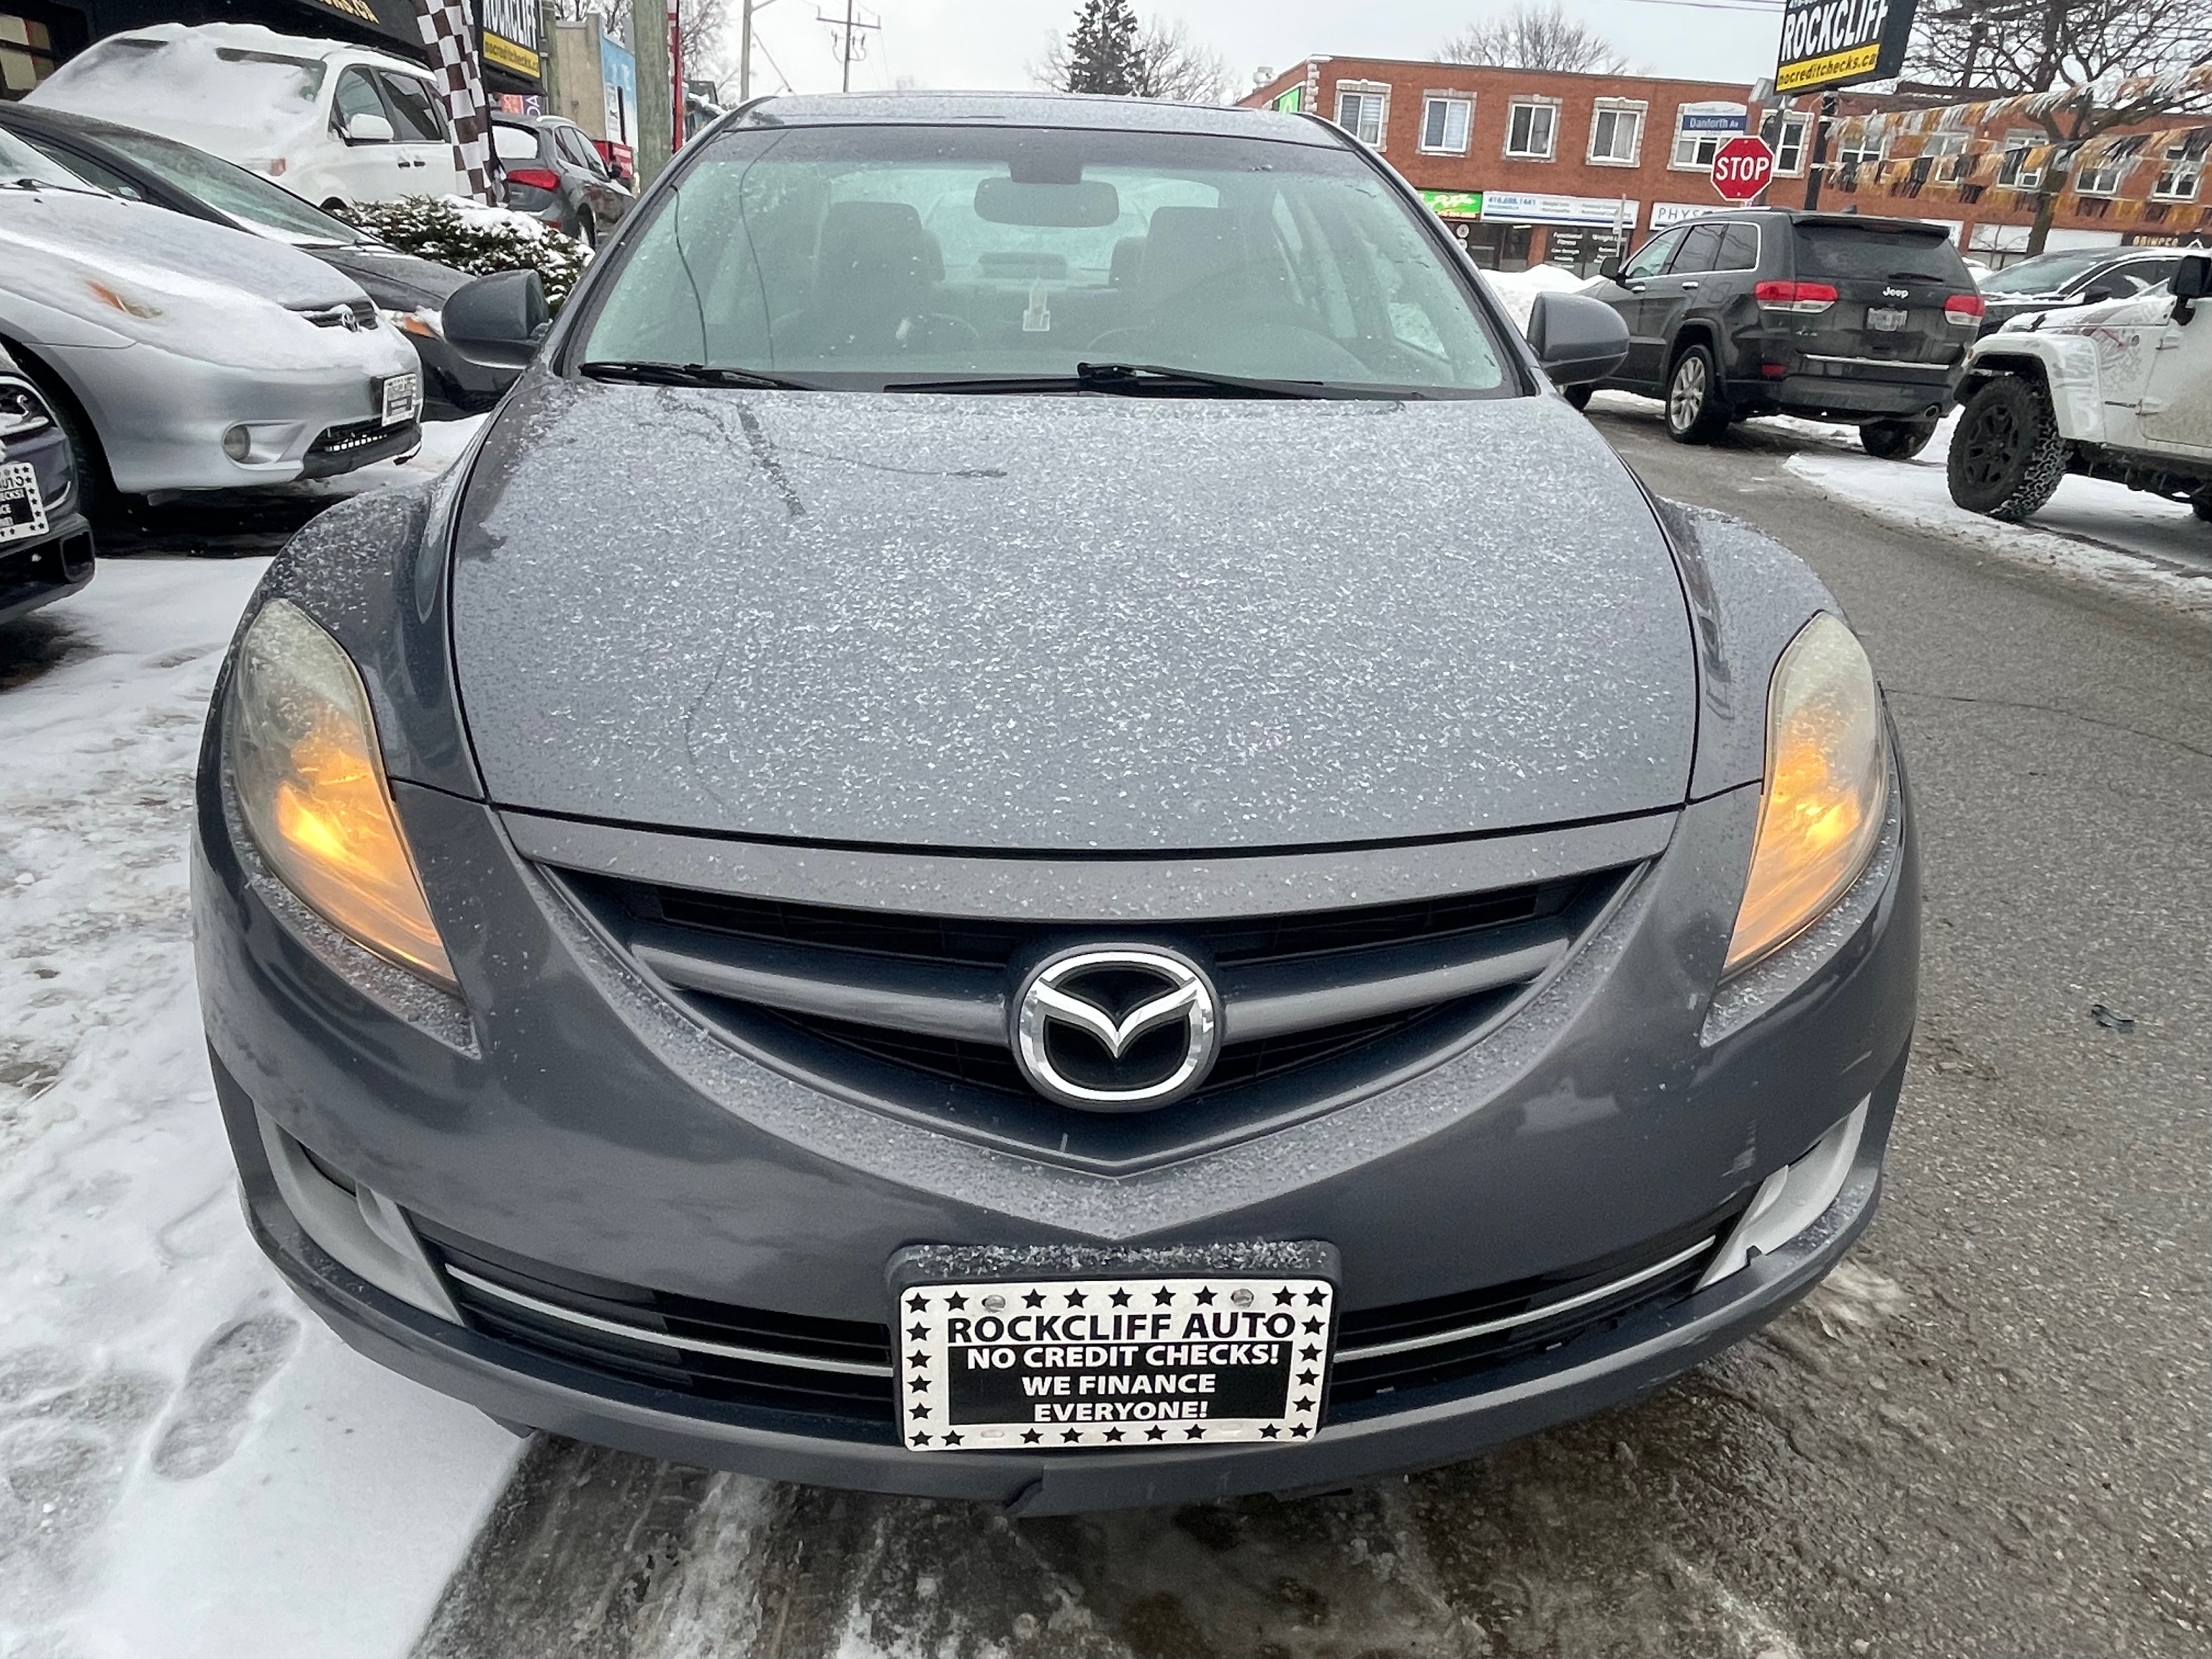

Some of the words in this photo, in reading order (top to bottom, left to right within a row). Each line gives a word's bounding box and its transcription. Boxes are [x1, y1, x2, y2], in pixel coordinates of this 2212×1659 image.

[1781, 0, 1889, 61] ROCKCLIFF
[1778, 53, 1877, 86] nocreditchecks.ca
[1689, 117, 1728, 129] Danforth
[1716, 156, 1770, 181] STOP
[1882, 287, 1909, 300] Jeep
[948, 1313, 1172, 1344] ROCKCLIFF
[1182, 1312, 1296, 1339] AUTO
[967, 1347, 1016, 1370] NO
[1023, 1345, 1138, 1367] CREDIT
[1146, 1344, 1279, 1366] CHECKS!
[1021, 1375, 1071, 1396] WE
[1079, 1373, 1215, 1395] FINANCE
[1034, 1401, 1208, 1422] EVERYONE!
